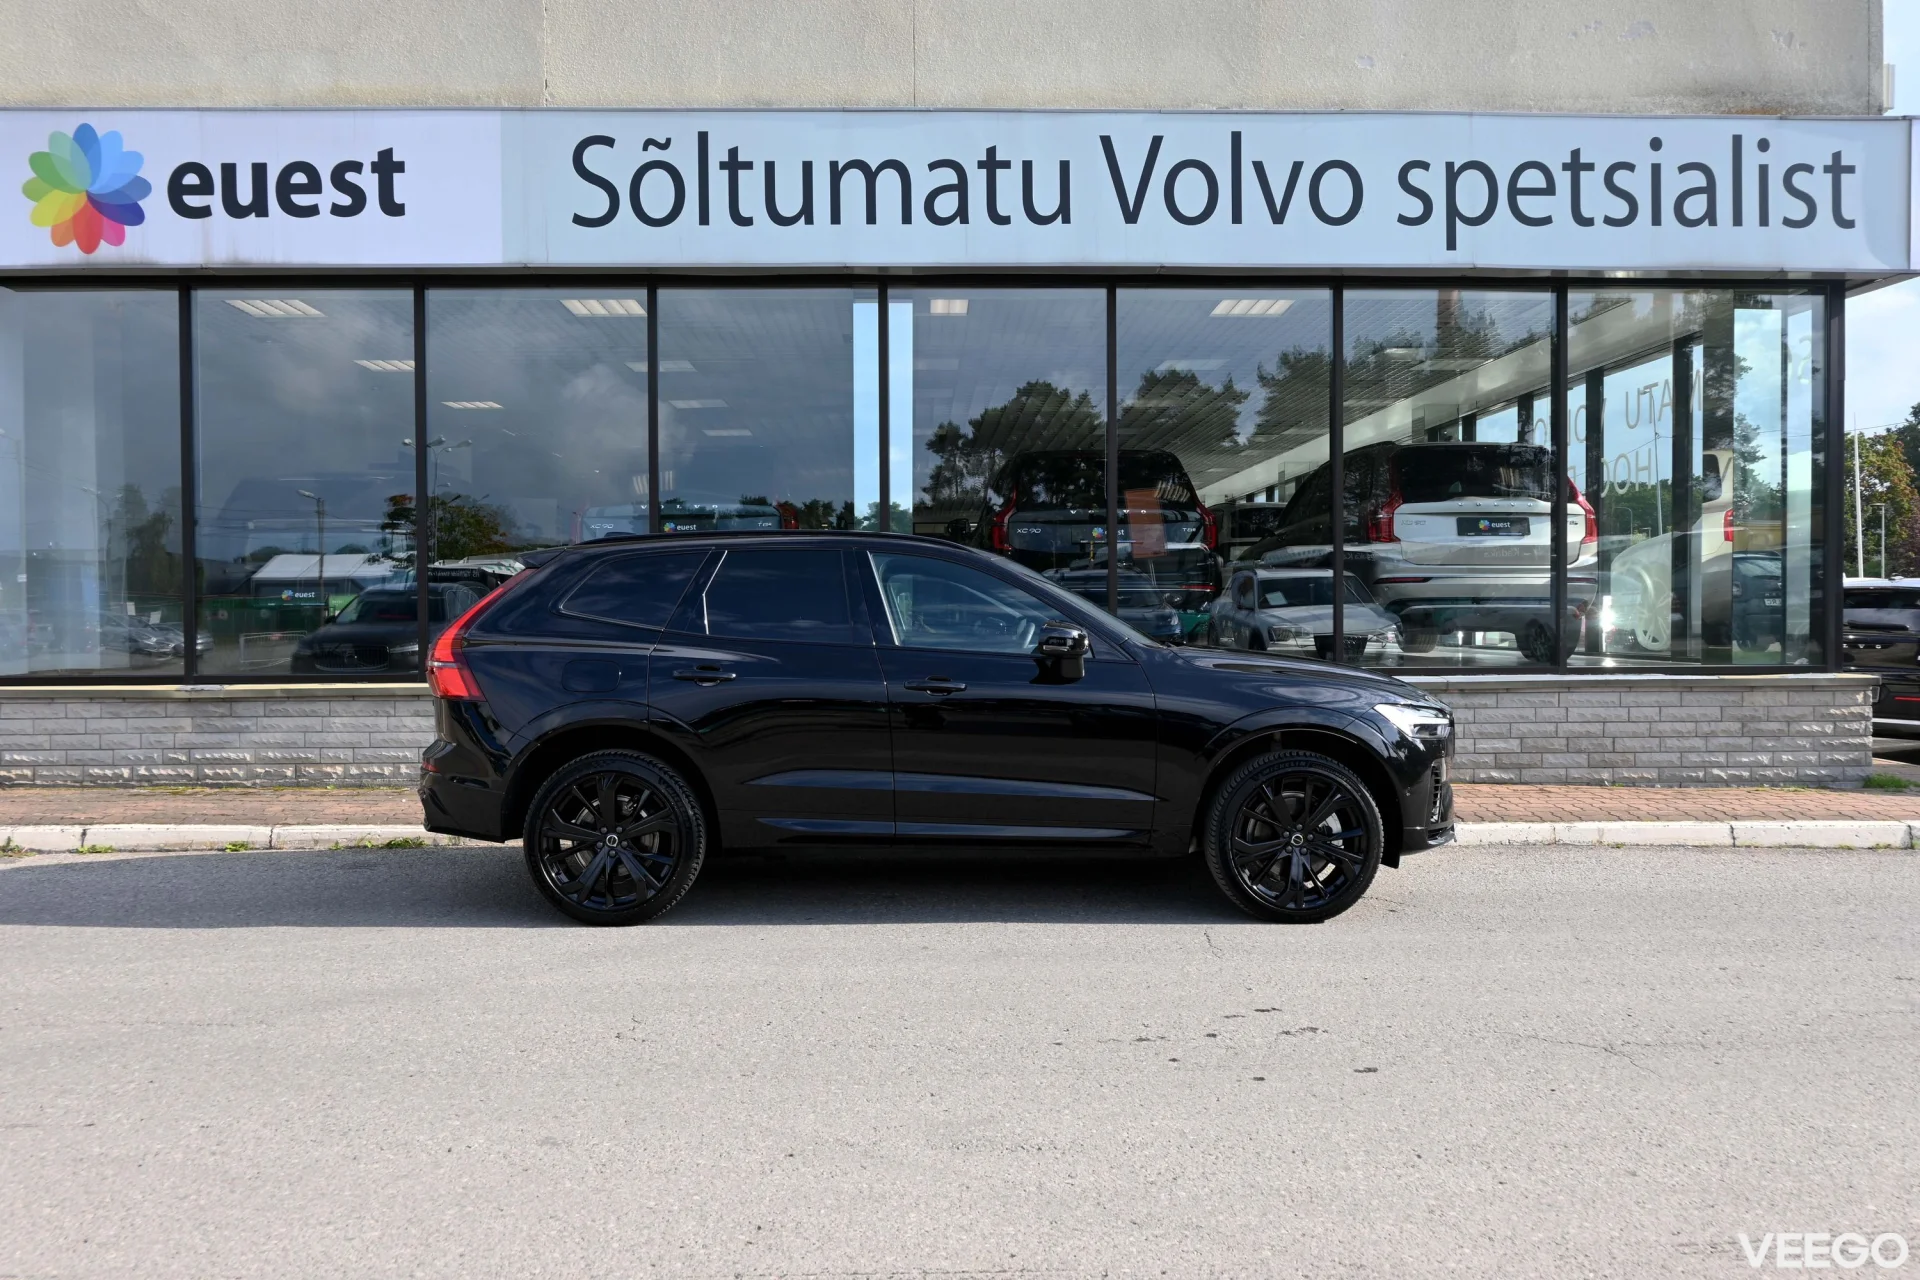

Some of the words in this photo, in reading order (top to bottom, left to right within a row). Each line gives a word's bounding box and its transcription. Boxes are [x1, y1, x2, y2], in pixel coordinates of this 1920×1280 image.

[167, 147, 405, 219] euest
[571, 131, 1072, 228] Sõltumatu
[1099, 131, 1365, 228] Volvo
[1397, 134, 1857, 251] spetsialist
